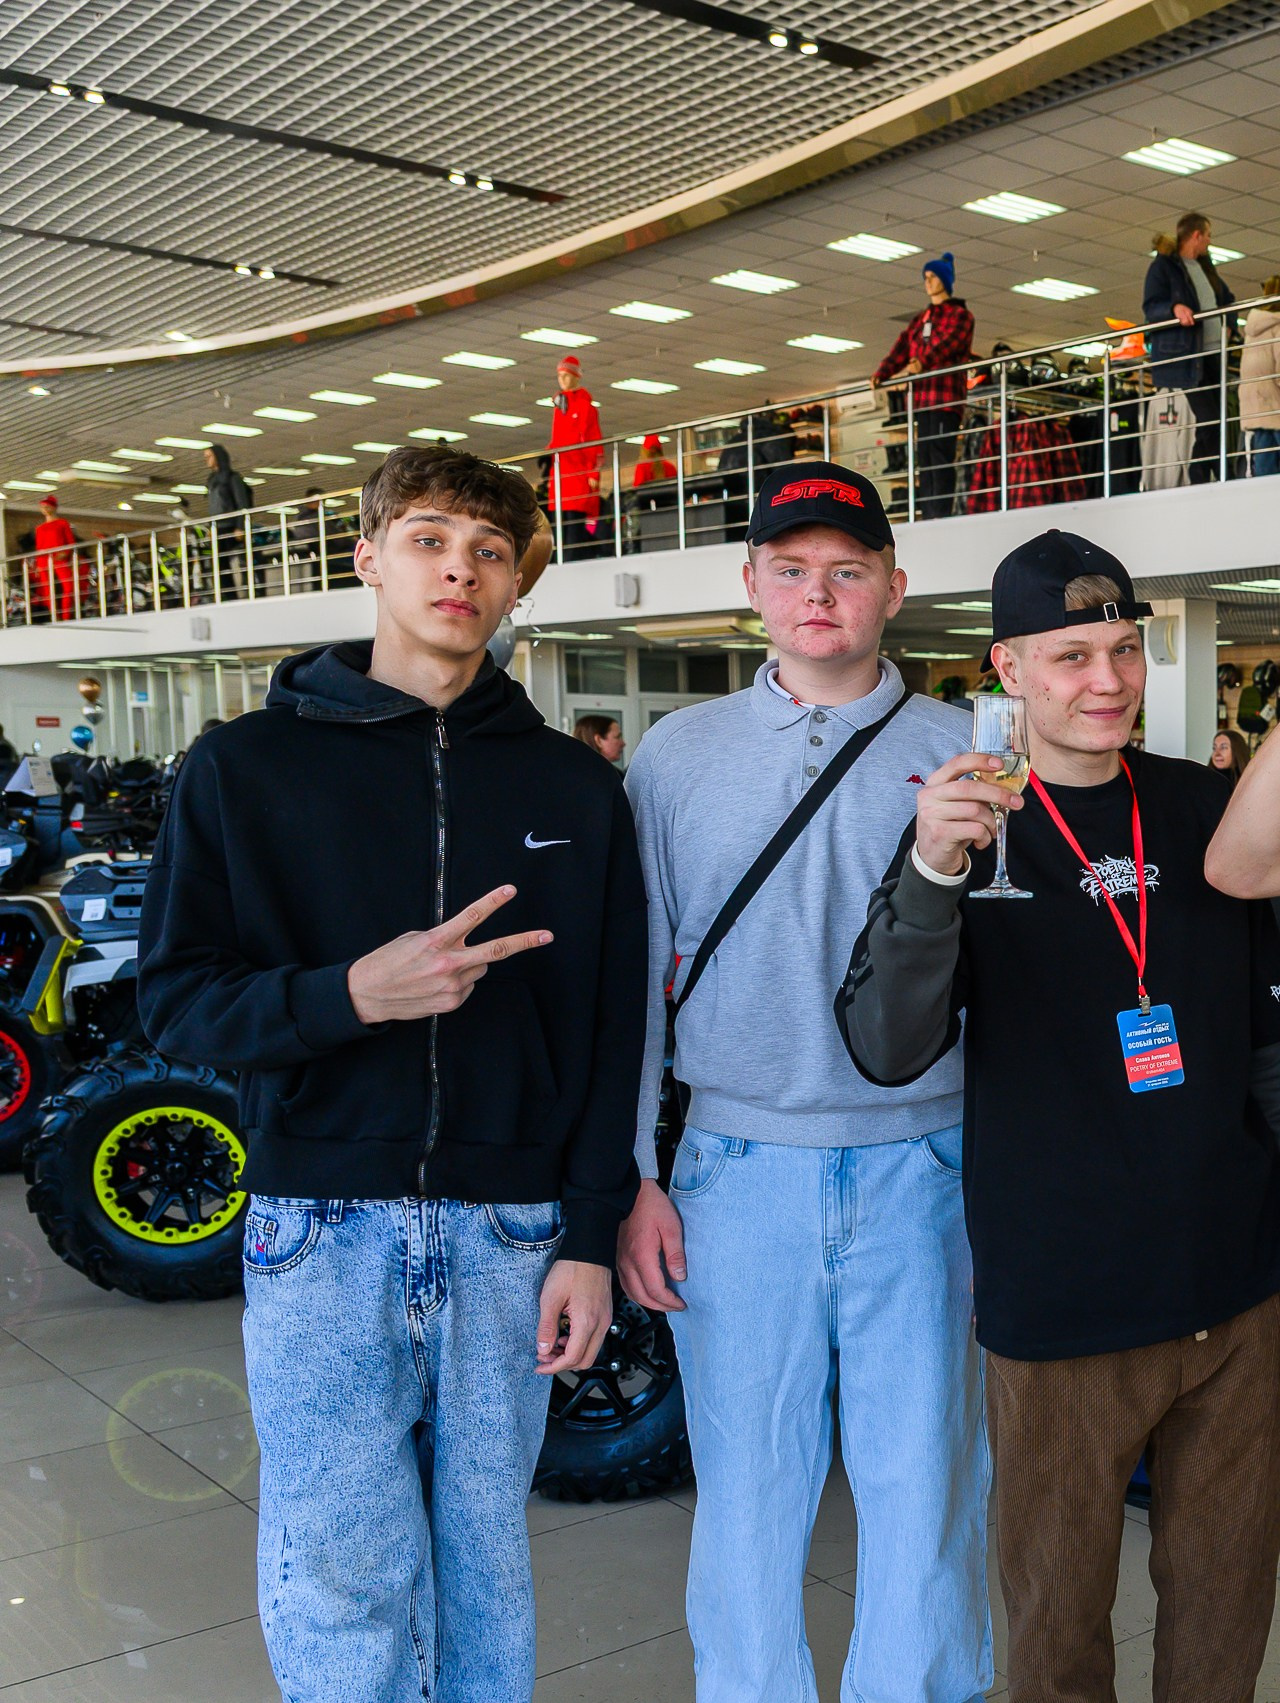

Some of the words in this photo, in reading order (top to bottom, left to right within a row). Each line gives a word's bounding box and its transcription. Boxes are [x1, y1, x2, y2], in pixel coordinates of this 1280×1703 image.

[770, 479, 865, 508] SPR
[1088, 854, 1137, 880] POETRY
[1086, 875, 1143, 897] EXTREM
[1127, 1038, 1153, 1050] ОСОБЫЙ
[1153, 1036, 1172, 1045] ГОСТЬ
[1130, 1064, 1149, 1073] POETRY
[1156, 1059, 1179, 1068] EXTREME
